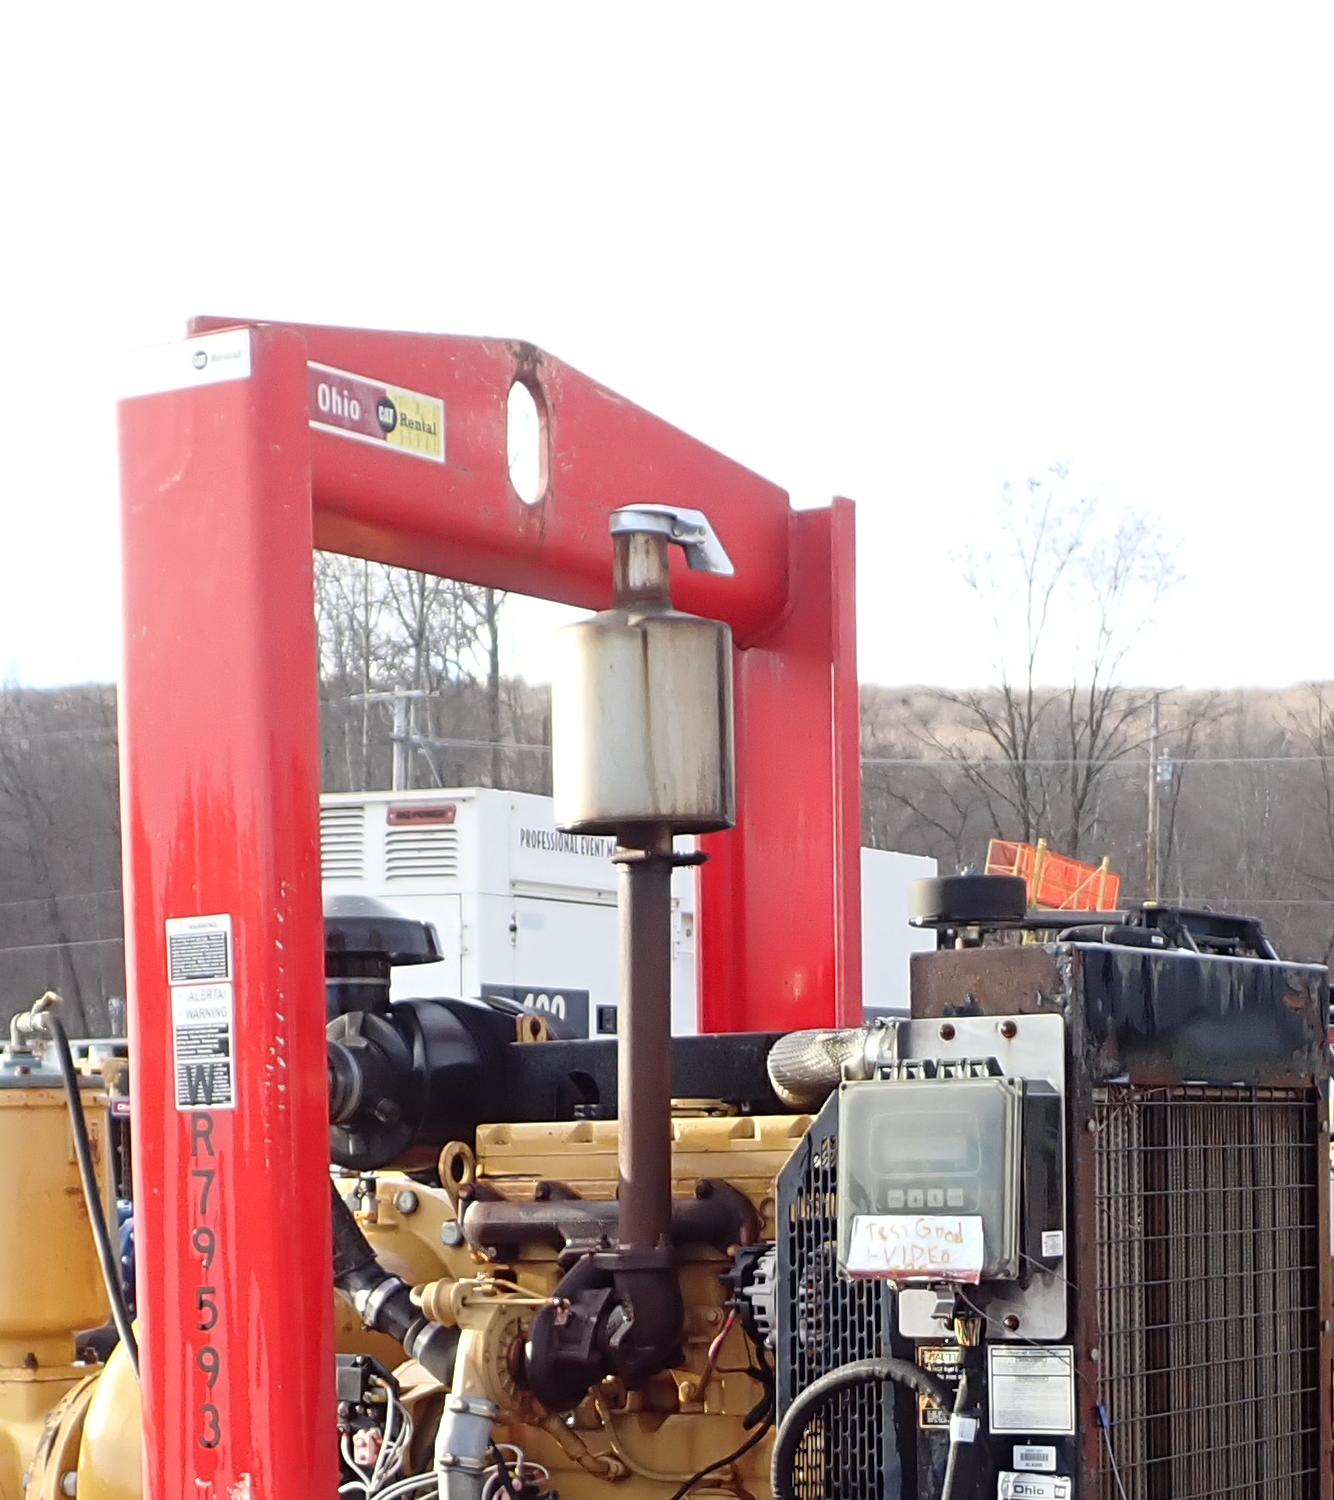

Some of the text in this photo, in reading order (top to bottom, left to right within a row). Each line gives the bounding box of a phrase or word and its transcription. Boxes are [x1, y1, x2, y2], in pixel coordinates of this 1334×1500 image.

[316, 382, 437, 437] Ohio CAT Rental
[519, 828, 579, 855] PROFESSIONAL
[580, 836, 605, 858] EVENT
[185, 1006, 228, 1020] WARNING
[1013, 1484, 1045, 1496] Ohio
